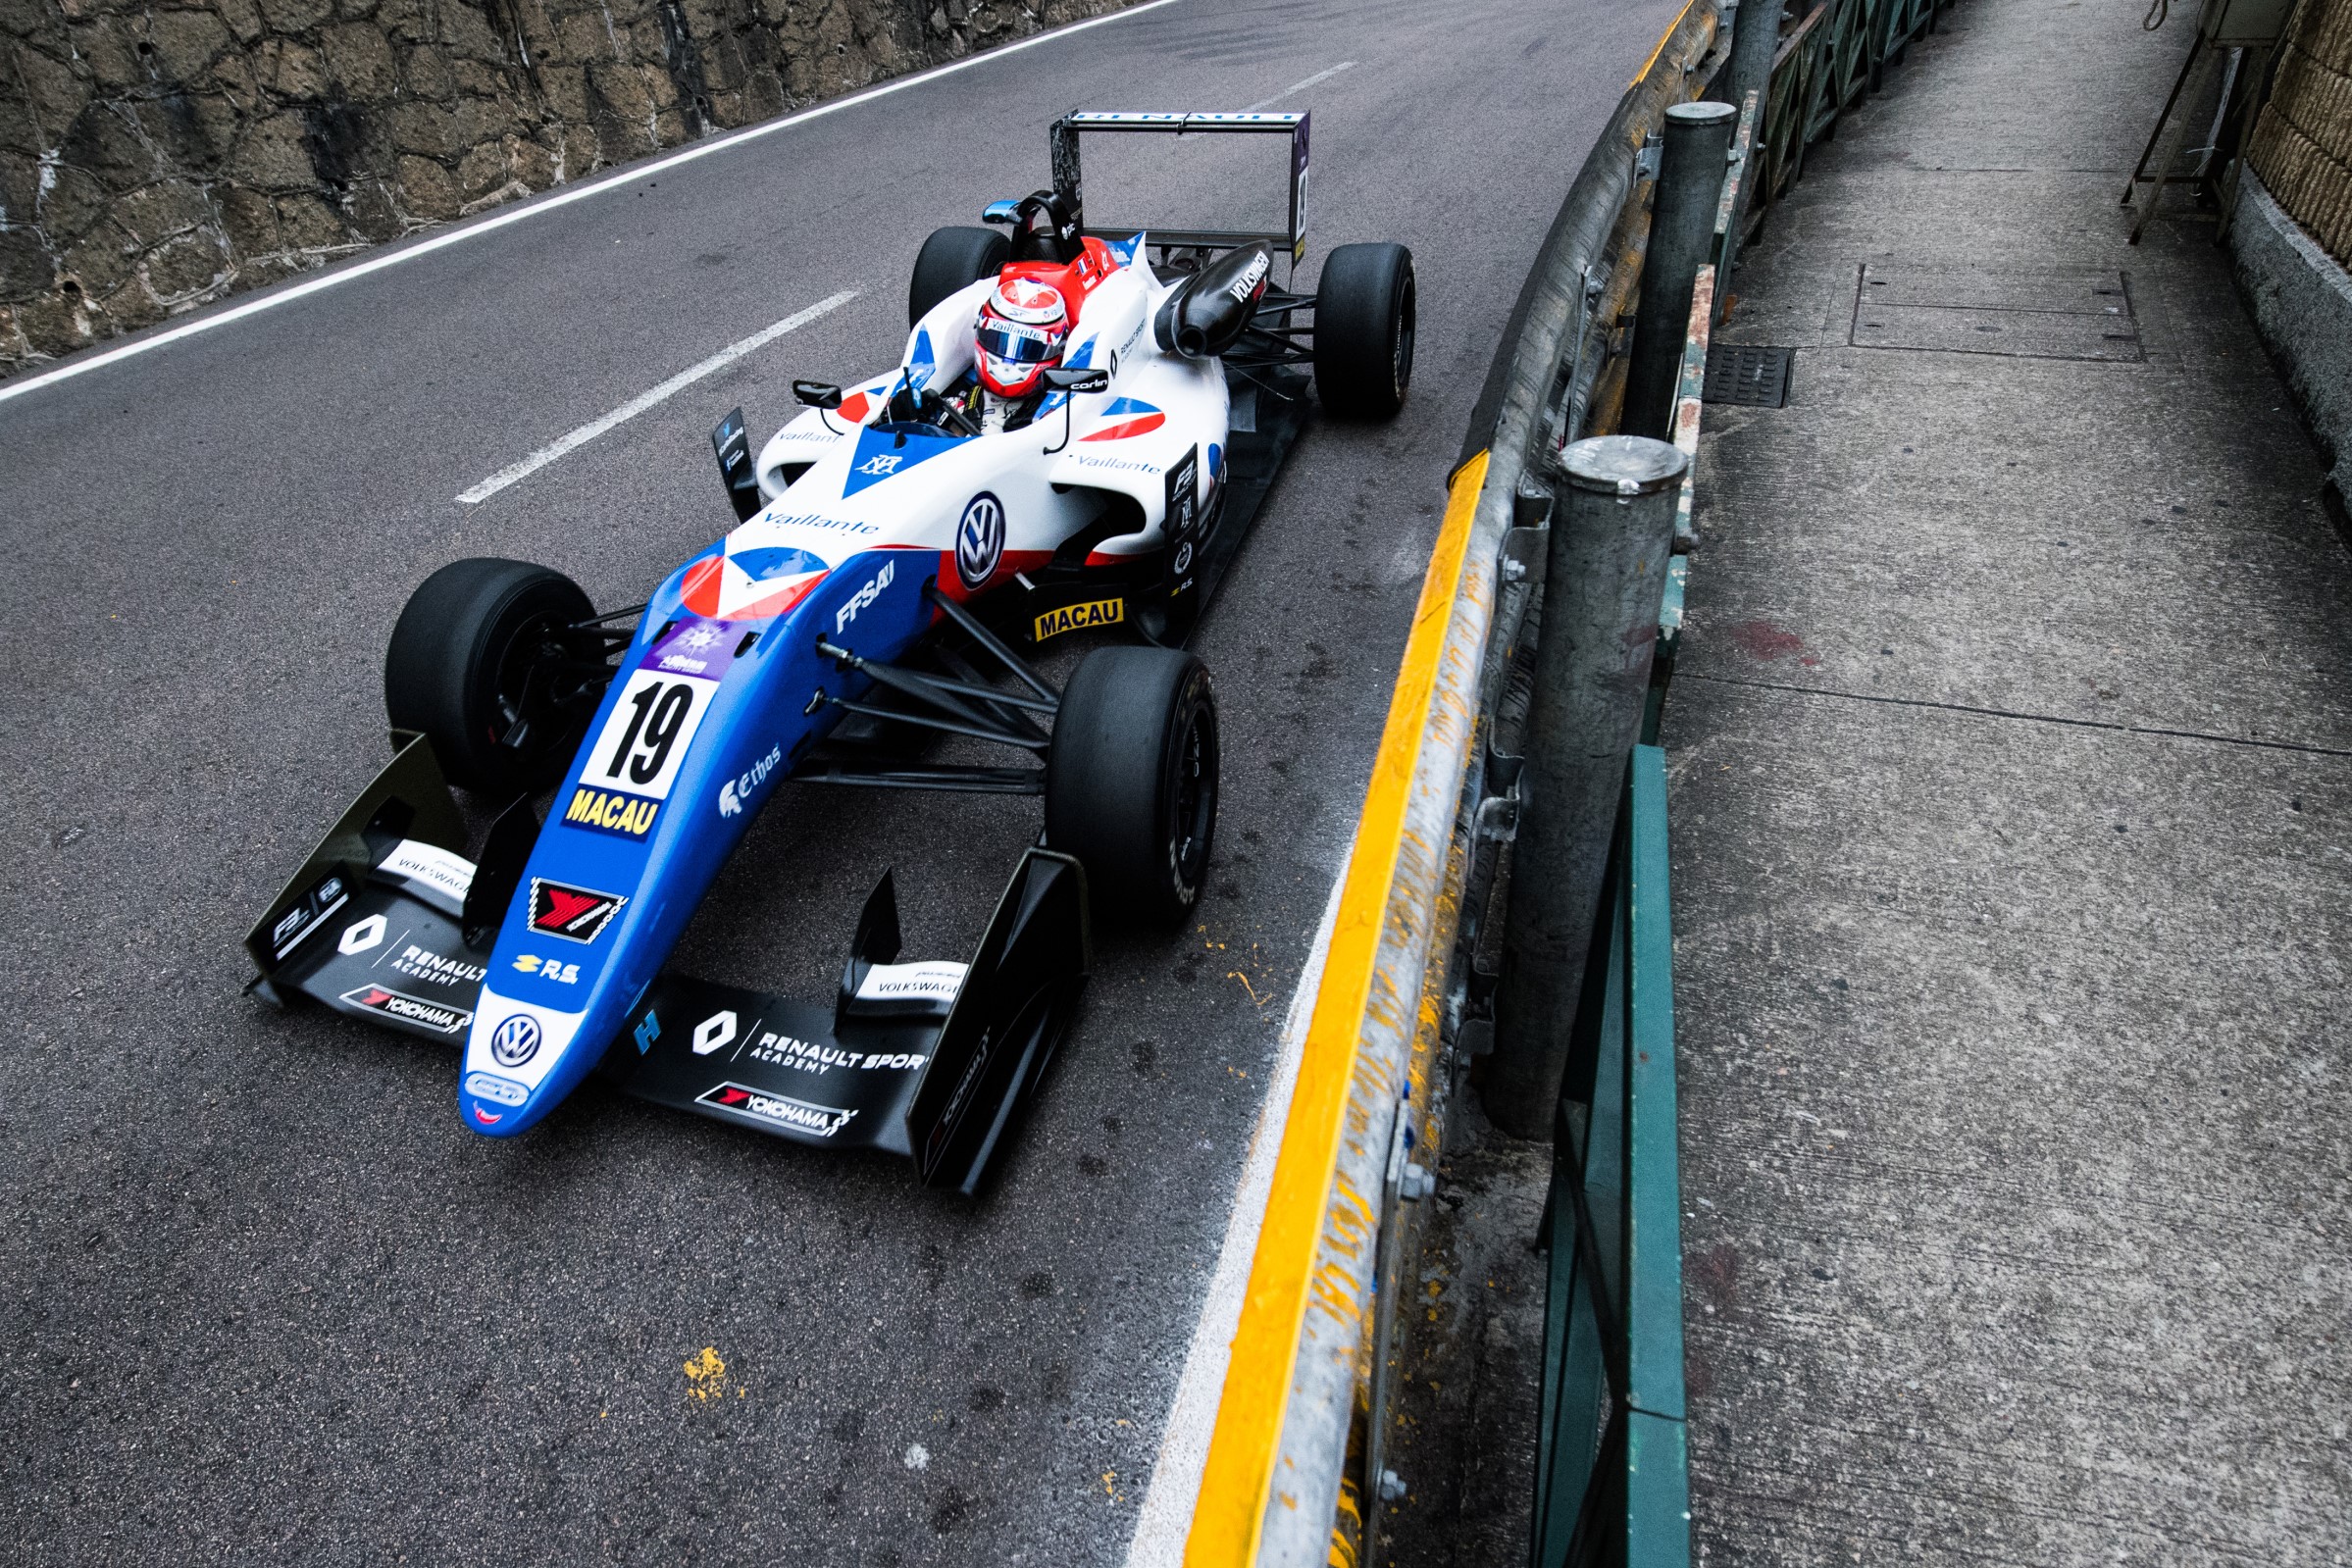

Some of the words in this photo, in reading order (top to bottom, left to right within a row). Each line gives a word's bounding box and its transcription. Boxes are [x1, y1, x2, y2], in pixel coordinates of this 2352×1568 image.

[992, 320, 1041, 340] Vaillante
[1080, 454, 1160, 476] Vaillante
[764, 512, 879, 535] Vaillante
[1040, 601, 1118, 638] MACAU
[605, 681, 695, 786] 19
[738, 742, 782, 799] Ethos
[565, 788, 659, 836] MACAU
[398, 859, 470, 893] VOLKSWAG
[390, 958, 461, 987] ACADEMY
[401, 944, 488, 983] RENAULT
[879, 982, 959, 993] VOLKSWAG
[384, 996, 456, 1027] YOKOHAMA
[749, 1046, 831, 1076] ACADEMY
[758, 1032, 864, 1068] RENAULT
[746, 1094, 830, 1130] YOKOHAMA
